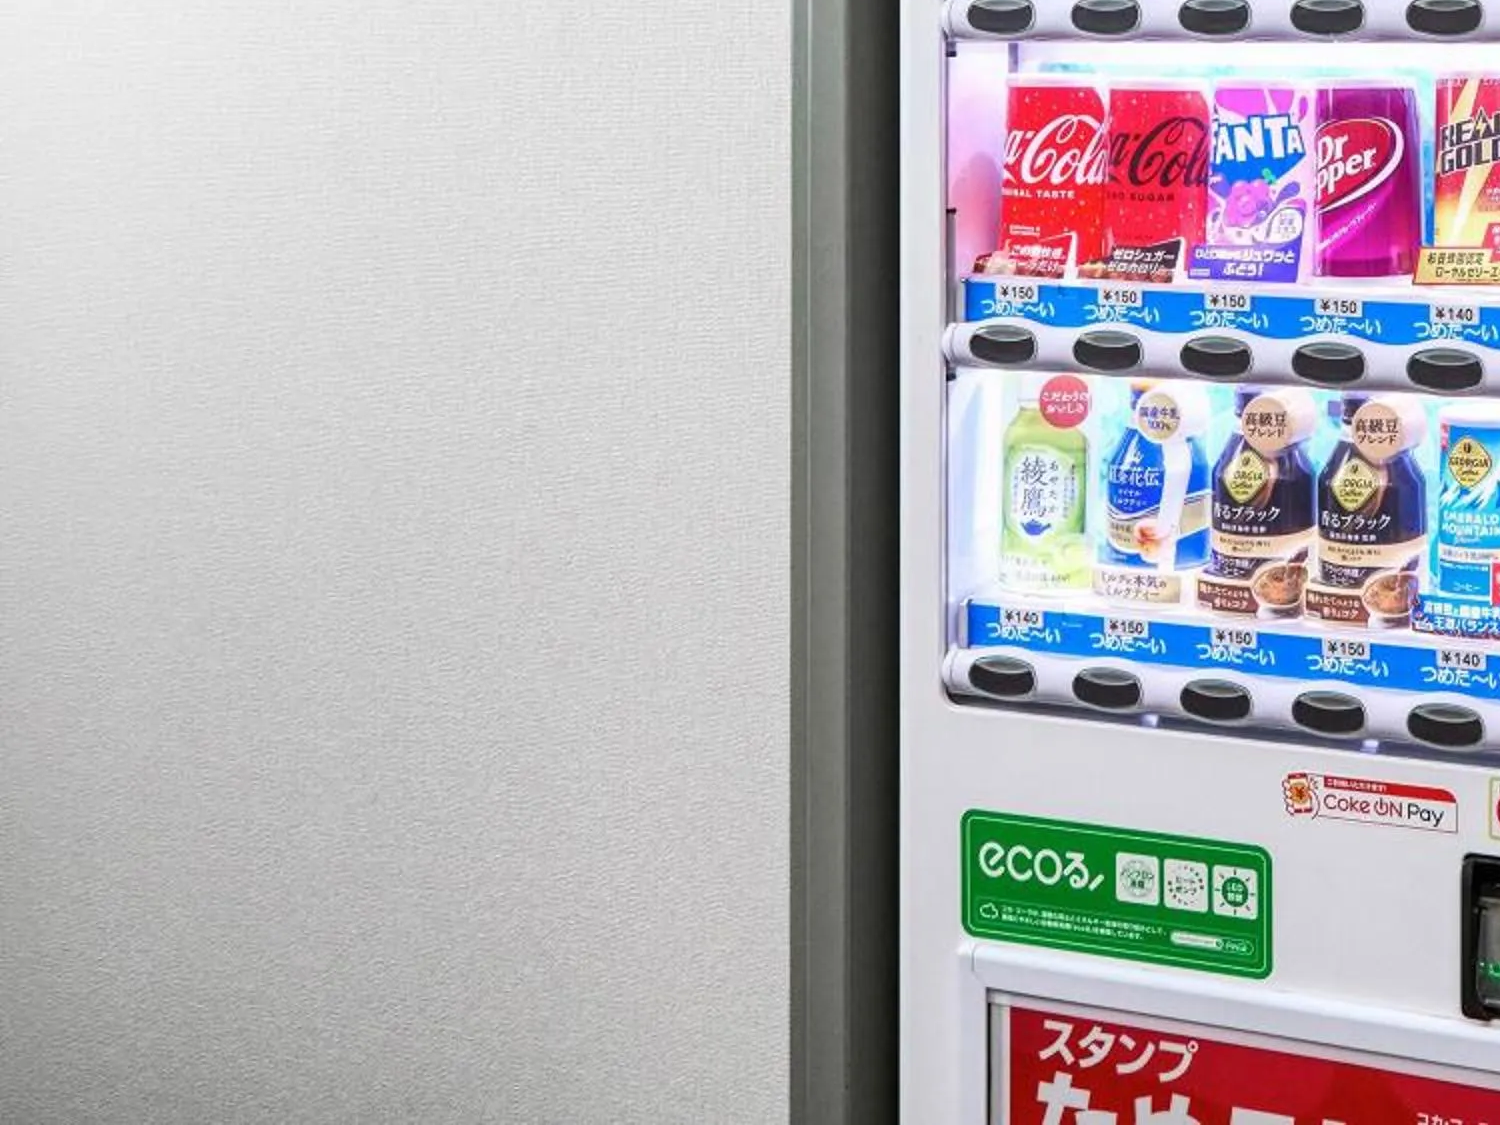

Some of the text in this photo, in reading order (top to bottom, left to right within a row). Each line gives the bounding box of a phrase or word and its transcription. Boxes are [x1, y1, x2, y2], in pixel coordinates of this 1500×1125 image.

[1035, 189, 1076, 200] TASTE
[1001, 287, 1035, 300] ¥150
[1103, 290, 1138, 304] ¥150
[1210, 295, 1246, 308] ¥150
[1320, 301, 1357, 315] ¥150
[1436, 308, 1473, 322] ¥140
[1005, 611, 1039, 624] ¥140
[1441, 650, 1481, 667] ¥140
[1323, 793, 1445, 827] Coke ON Pay
[1038, 1019, 1199, 1083] スタンプ
